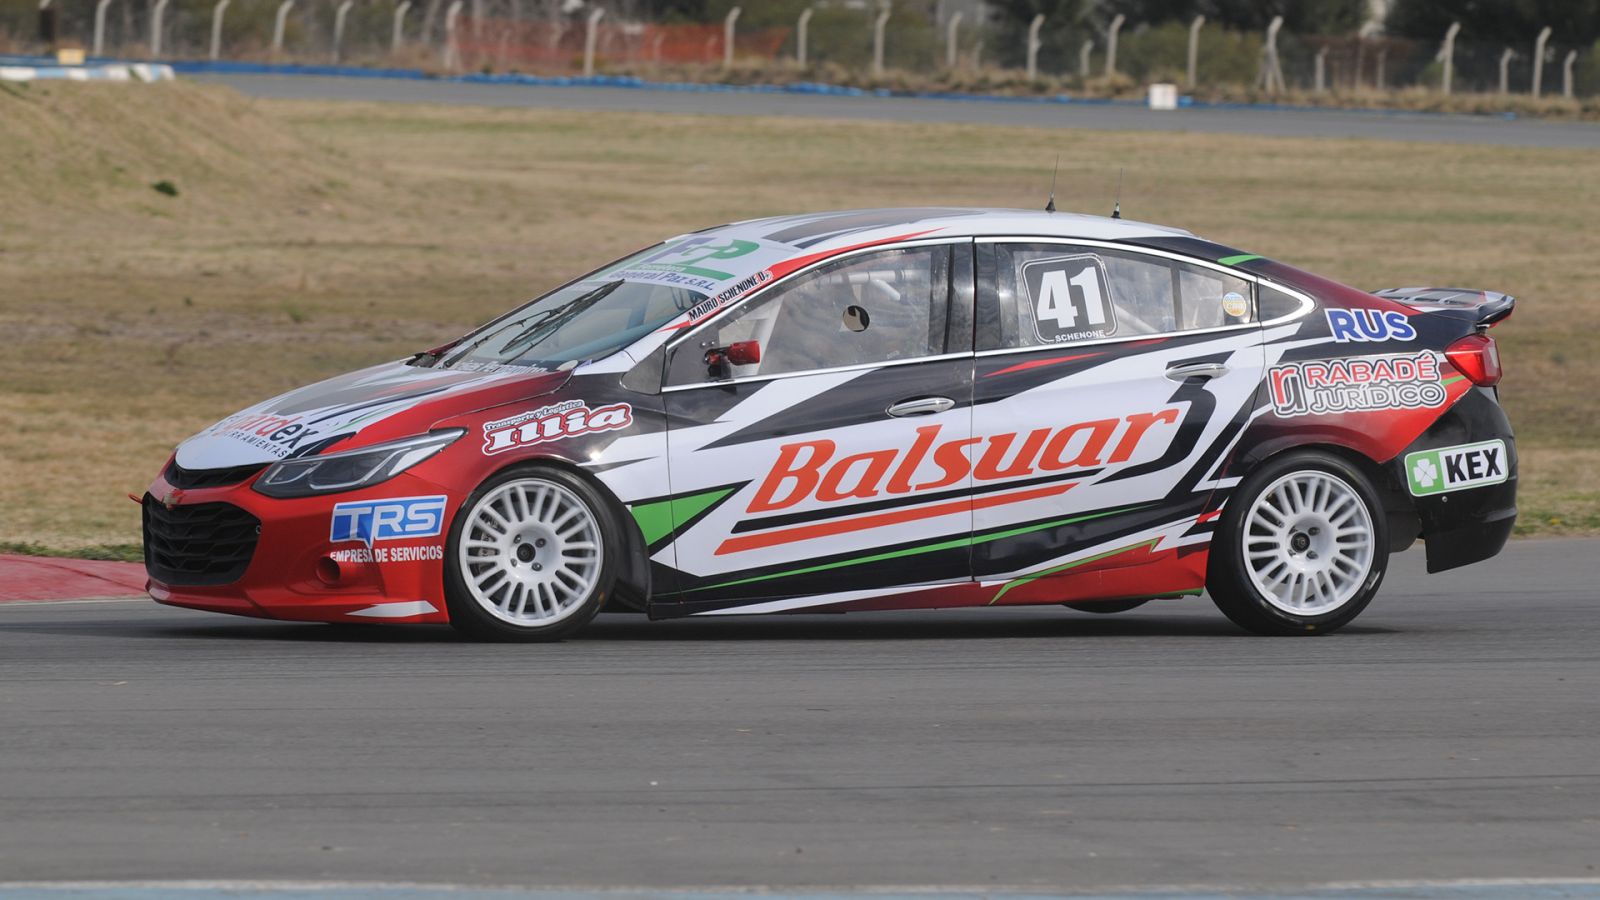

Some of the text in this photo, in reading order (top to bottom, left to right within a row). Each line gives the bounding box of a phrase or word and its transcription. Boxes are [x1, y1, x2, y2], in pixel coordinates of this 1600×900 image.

[659, 271, 688, 284] Paz
[688, 298, 718, 321] MAURO
[719, 273, 760, 304] SCHENONE
[1037, 266, 1106, 329] 41
[1055, 330, 1105, 344] SCHENONE
[1327, 309, 1414, 340] RUS
[1306, 356, 1437, 386] RABADÉ
[1312, 386, 1440, 412] JURÍDICO
[745, 408, 1180, 514] Balsuar
[1445, 448, 1502, 483] KEX
[333, 501, 443, 539] TRS
[330, 545, 443, 563] EMPRESA DE SERVICIOS
